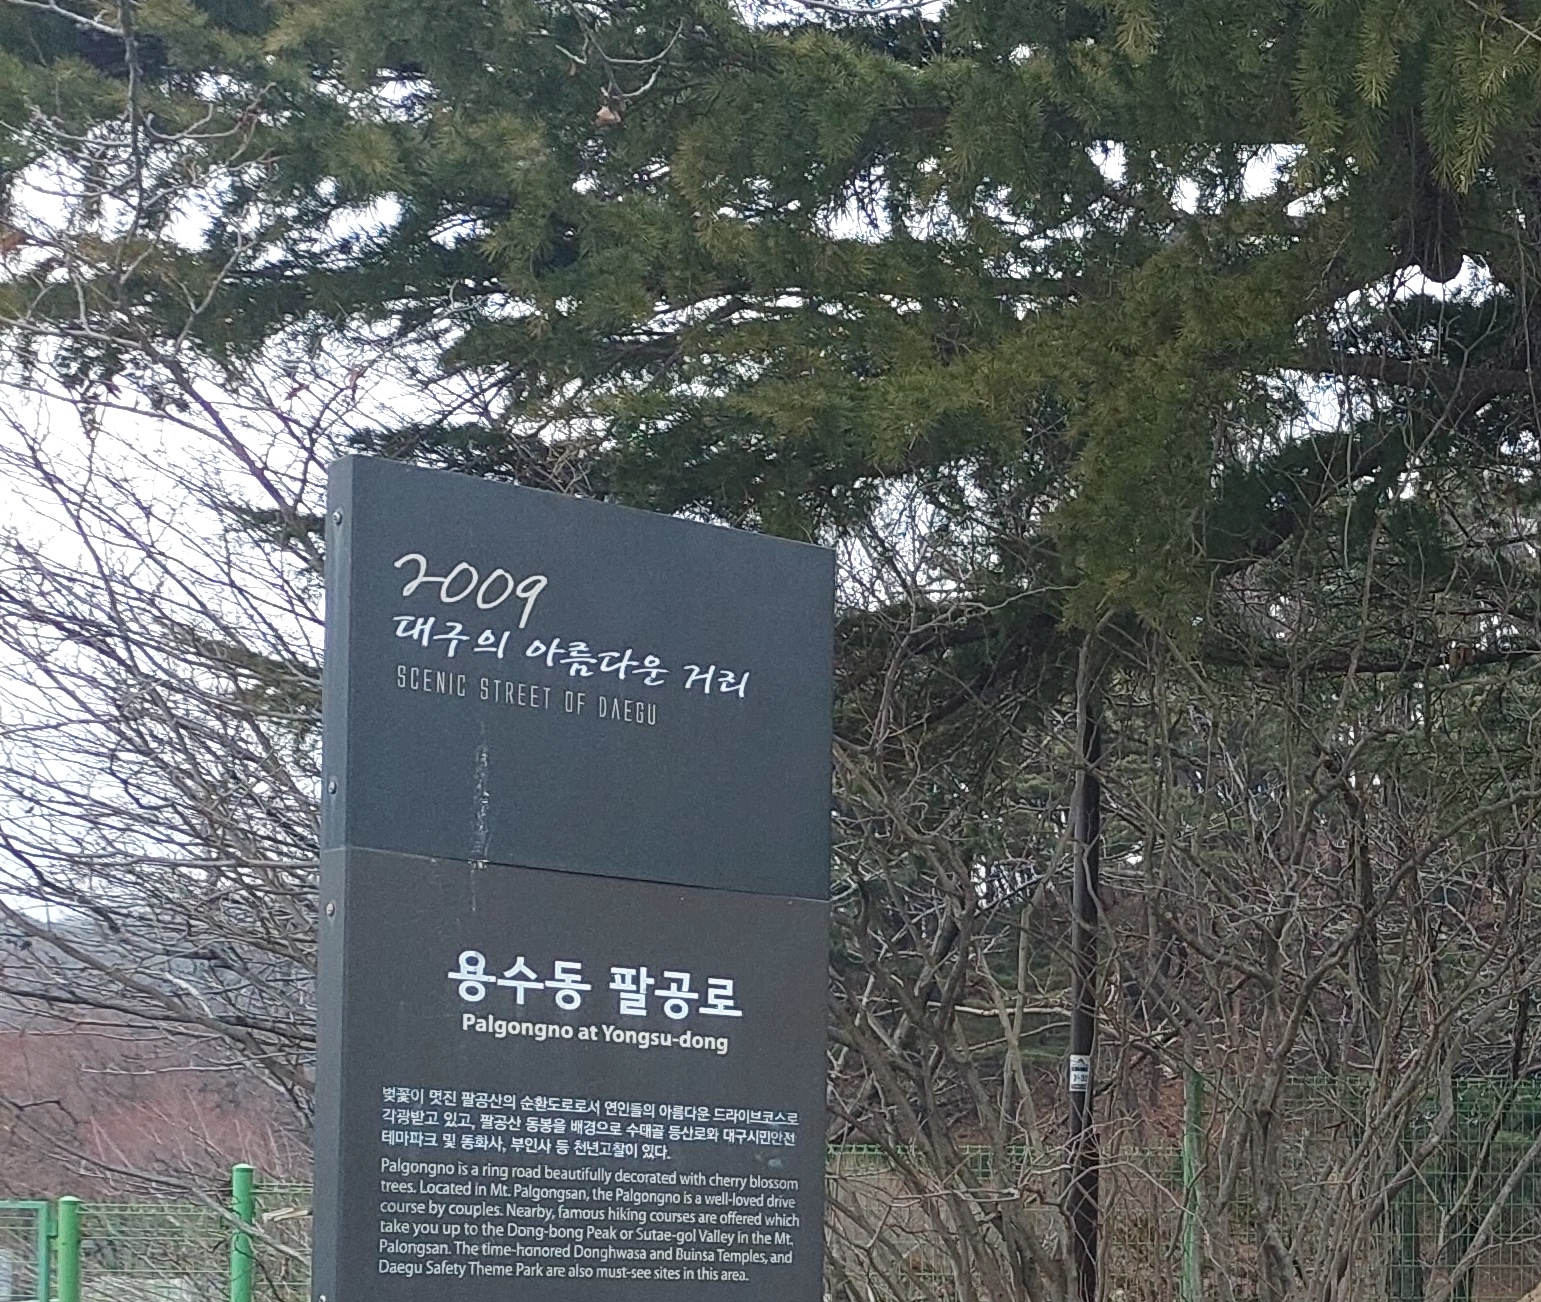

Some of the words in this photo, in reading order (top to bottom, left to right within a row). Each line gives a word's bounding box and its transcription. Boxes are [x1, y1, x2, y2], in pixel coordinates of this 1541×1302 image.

[394, 554, 548, 628] 2009
[393, 615, 511, 658] 대구의
[525, 638, 670, 685] 아름다운
[683, 664, 750, 697] 거리
[397, 665, 466, 697] SCENIC
[480, 678, 551, 709] STREET
[565, 691, 586, 715] OF
[599, 696, 657, 725] DAEGU
[447, 950, 591, 1010] 용수동
[609, 966, 742, 1020] 팔공로
[462, 1013, 573, 1041] Palgongno
[578, 1026, 598, 1041] at
[601, 1025, 729, 1055] Yongsu-dong
[429, 1089, 457, 1106] 멋진
[461, 1091, 516, 1110] 팔공산의
[519, 1095, 600, 1116] 순환도로로서
[604, 1101, 655, 1117] 연인들의
[659, 1104, 710, 1122] 아름다운
[713, 1108, 800, 1125] 드라이브코스로
[381, 1130, 438, 1147] 테마파크
[442, 1133, 456, 1149] 및
[461, 1134, 506, 1153] 동화사,
[510, 1137, 551, 1154] 부인사
[555, 1138, 570, 1155] 등
[574, 1139, 638, 1158] 천년고찰이
[642, 1144, 672, 1160] 있다.
[382, 1109, 439, 1126] 각광받고
[444, 1111, 475, 1130] 있고,
[480, 1114, 521, 1131] 팔공산
[526, 1117, 566, 1134] 동봉을
[570, 1119, 622, 1136] 배경으로
[668, 1125, 719, 1142] 등산로와
[723, 1129, 796, 1146] 대구시민안전
[381, 1157, 454, 1177] Palgongno
[458, 1162, 468, 1175] is
[471, 1165, 478, 1176] a
[482, 1163, 508, 1180] ring
[511, 1165, 541, 1178] road
[544, 1165, 612, 1185] beautifully
[615, 1169, 676, 1184] decorated
[679, 1172, 706, 1186] with
[709, 1173, 747, 1191] cherry
[750, 1175, 798, 1190] blossom
[381, 1180, 416, 1193] trees.
[420, 1180, 471, 1195] Located
[475, 1182, 487, 1196] in
[490, 1183, 511, 1197] Mt.
[514, 1184, 590, 1202] Palgongsan,
[592, 1188, 612, 1201] the
[616, 1188, 680, 1206] Palgongno
[684, 1191, 692, 1204] is
[695, 1195, 701, 1204] a
[705, 1192, 764, 1207] well-loved
[767, 1194, 796, 1209] drive
[380, 1202, 425, 1214] course
[429, 1200, 446, 1218] by
[448, 1202, 503, 1218] couples.
[507, 1203, 555, 1222] Nearby,
[558, 1205, 605, 1220] famous
[608, 1207, 647, 1224] hiking
[650, 1212, 695, 1224] courses
[698, 1213, 717, 1224] are
[720, 1210, 761, 1226] offered
[765, 1213, 799, 1227] which
[380, 1220, 409, 1234] take
[412, 1223, 439, 1237] you
[443, 1224, 460, 1239] up
[464, 1223, 478, 1236] to
[482, 1223, 504, 1236] the
[507, 1223, 583, 1241] Dong-bong
[587, 1226, 617, 1240] Peak
[620, 1229, 633, 1240] or
[636, 1227, 696, 1244] Sutae-gol
[699, 1230, 735, 1246] Valley
[738, 1231, 749, 1243] in
[751, 1231, 772, 1244] the
[379, 1239, 450, 1258] Palongsan.
[454, 1241, 478, 1256] The
[481, 1242, 571, 1258] time-honored
[574, 1244, 647, 1262] Donghwasa
[650, 1247, 672, 1261] and
[676, 1249, 715, 1262] Buinsa
[717, 1249, 768, 1265] Temples,
[770, 1250, 793, 1264] and
[378, 1260, 422, 1277] Daegu
[426, 1260, 467, 1278] Safety
[468, 1261, 513, 1276] Theme
[515, 1262, 544, 1277] Park
[546, 1266, 566, 1277] are
[568, 1263, 593, 1277] also
[596, 1266, 651, 1279] must-see
[654, 1267, 680, 1280] sites
[684, 1267, 694, 1280] in
[697, 1267, 718, 1280] this
[721, 1270, 749, 1281] area.
